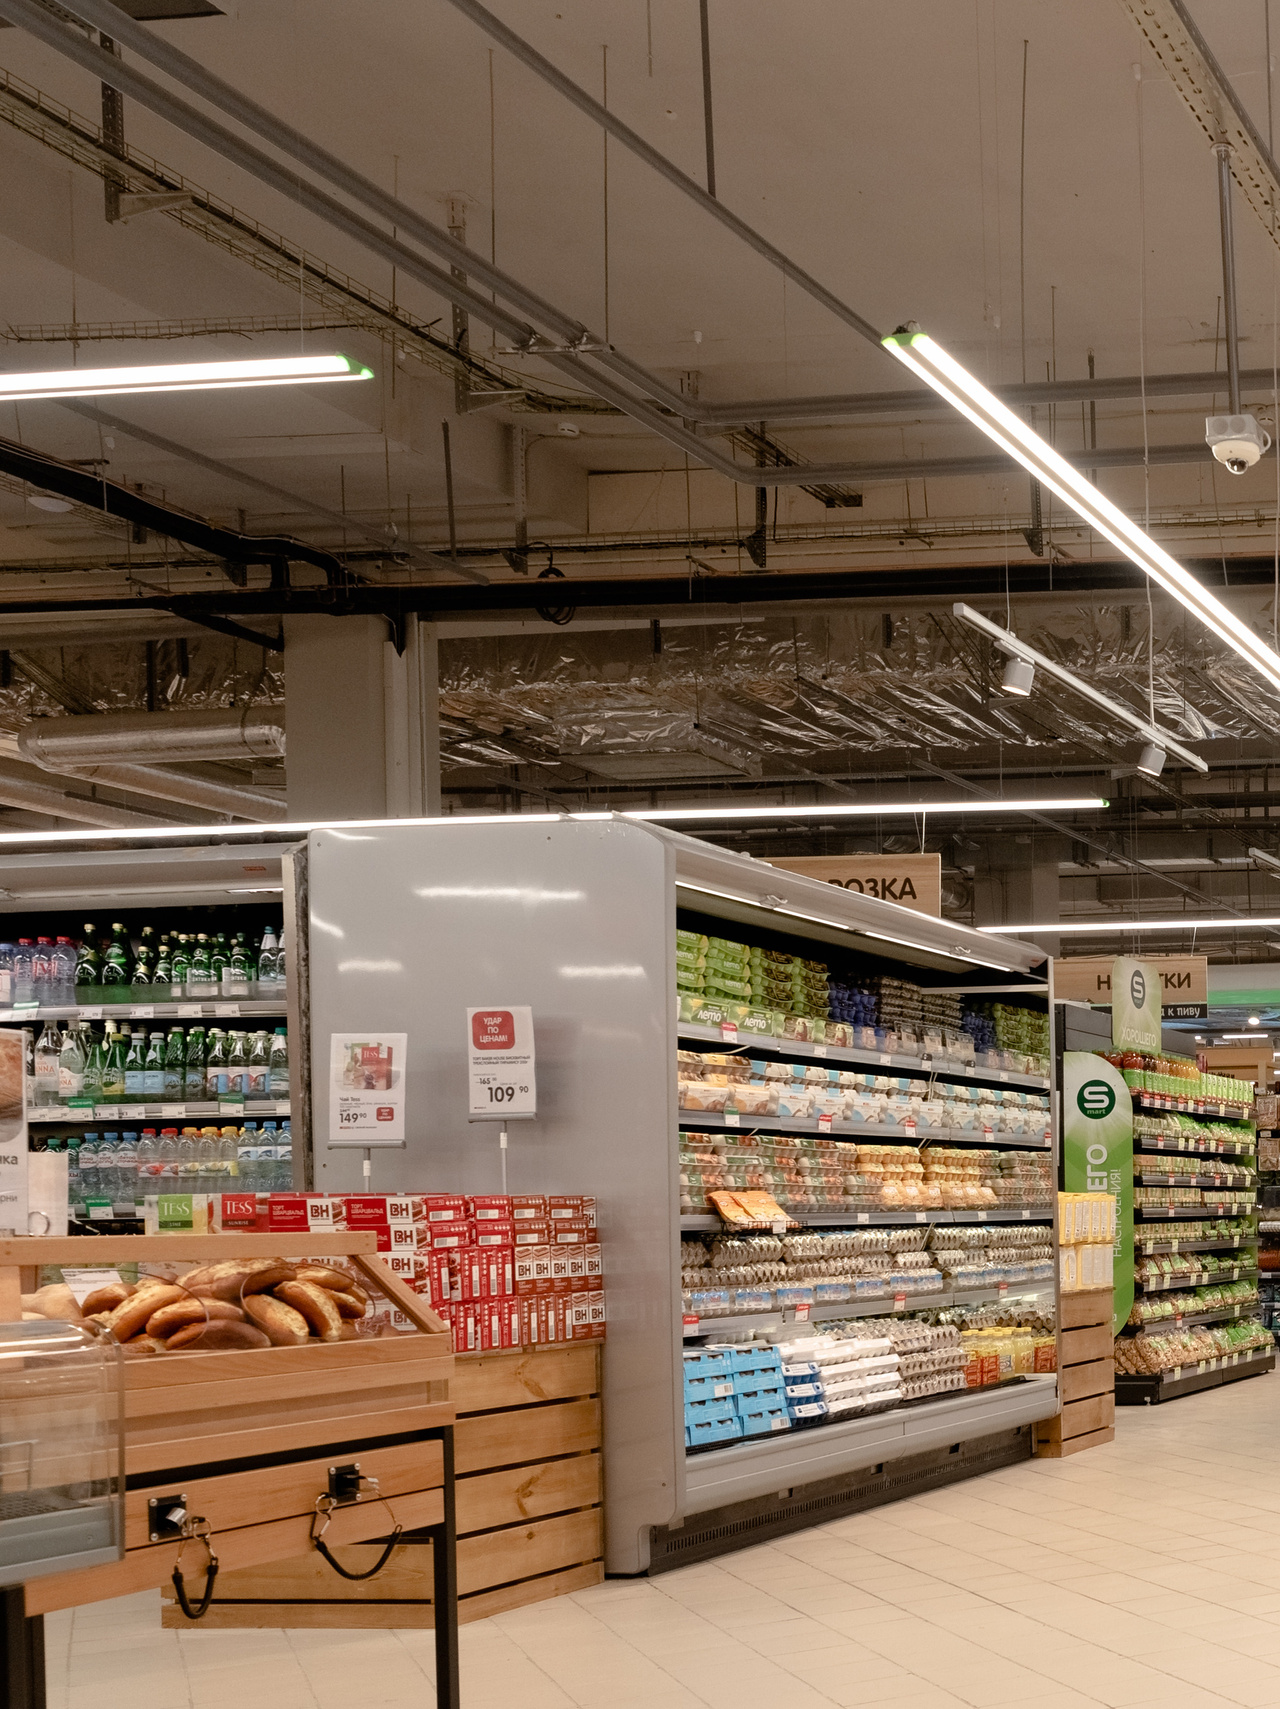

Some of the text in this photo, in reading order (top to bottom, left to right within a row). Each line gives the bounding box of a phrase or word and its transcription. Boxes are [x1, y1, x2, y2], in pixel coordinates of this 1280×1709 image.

[1176, 1006, 1200, 1018] пиву
[483, 1017, 502, 1025] УДАР
[480, 1035, 508, 1043] ЦЕНАМ!
[487, 1085, 529, 1102] 109 90
[339, 1113, 359, 1123] 149
[161, 1202, 190, 1216] TESS
[225, 1200, 253, 1215] TESS
